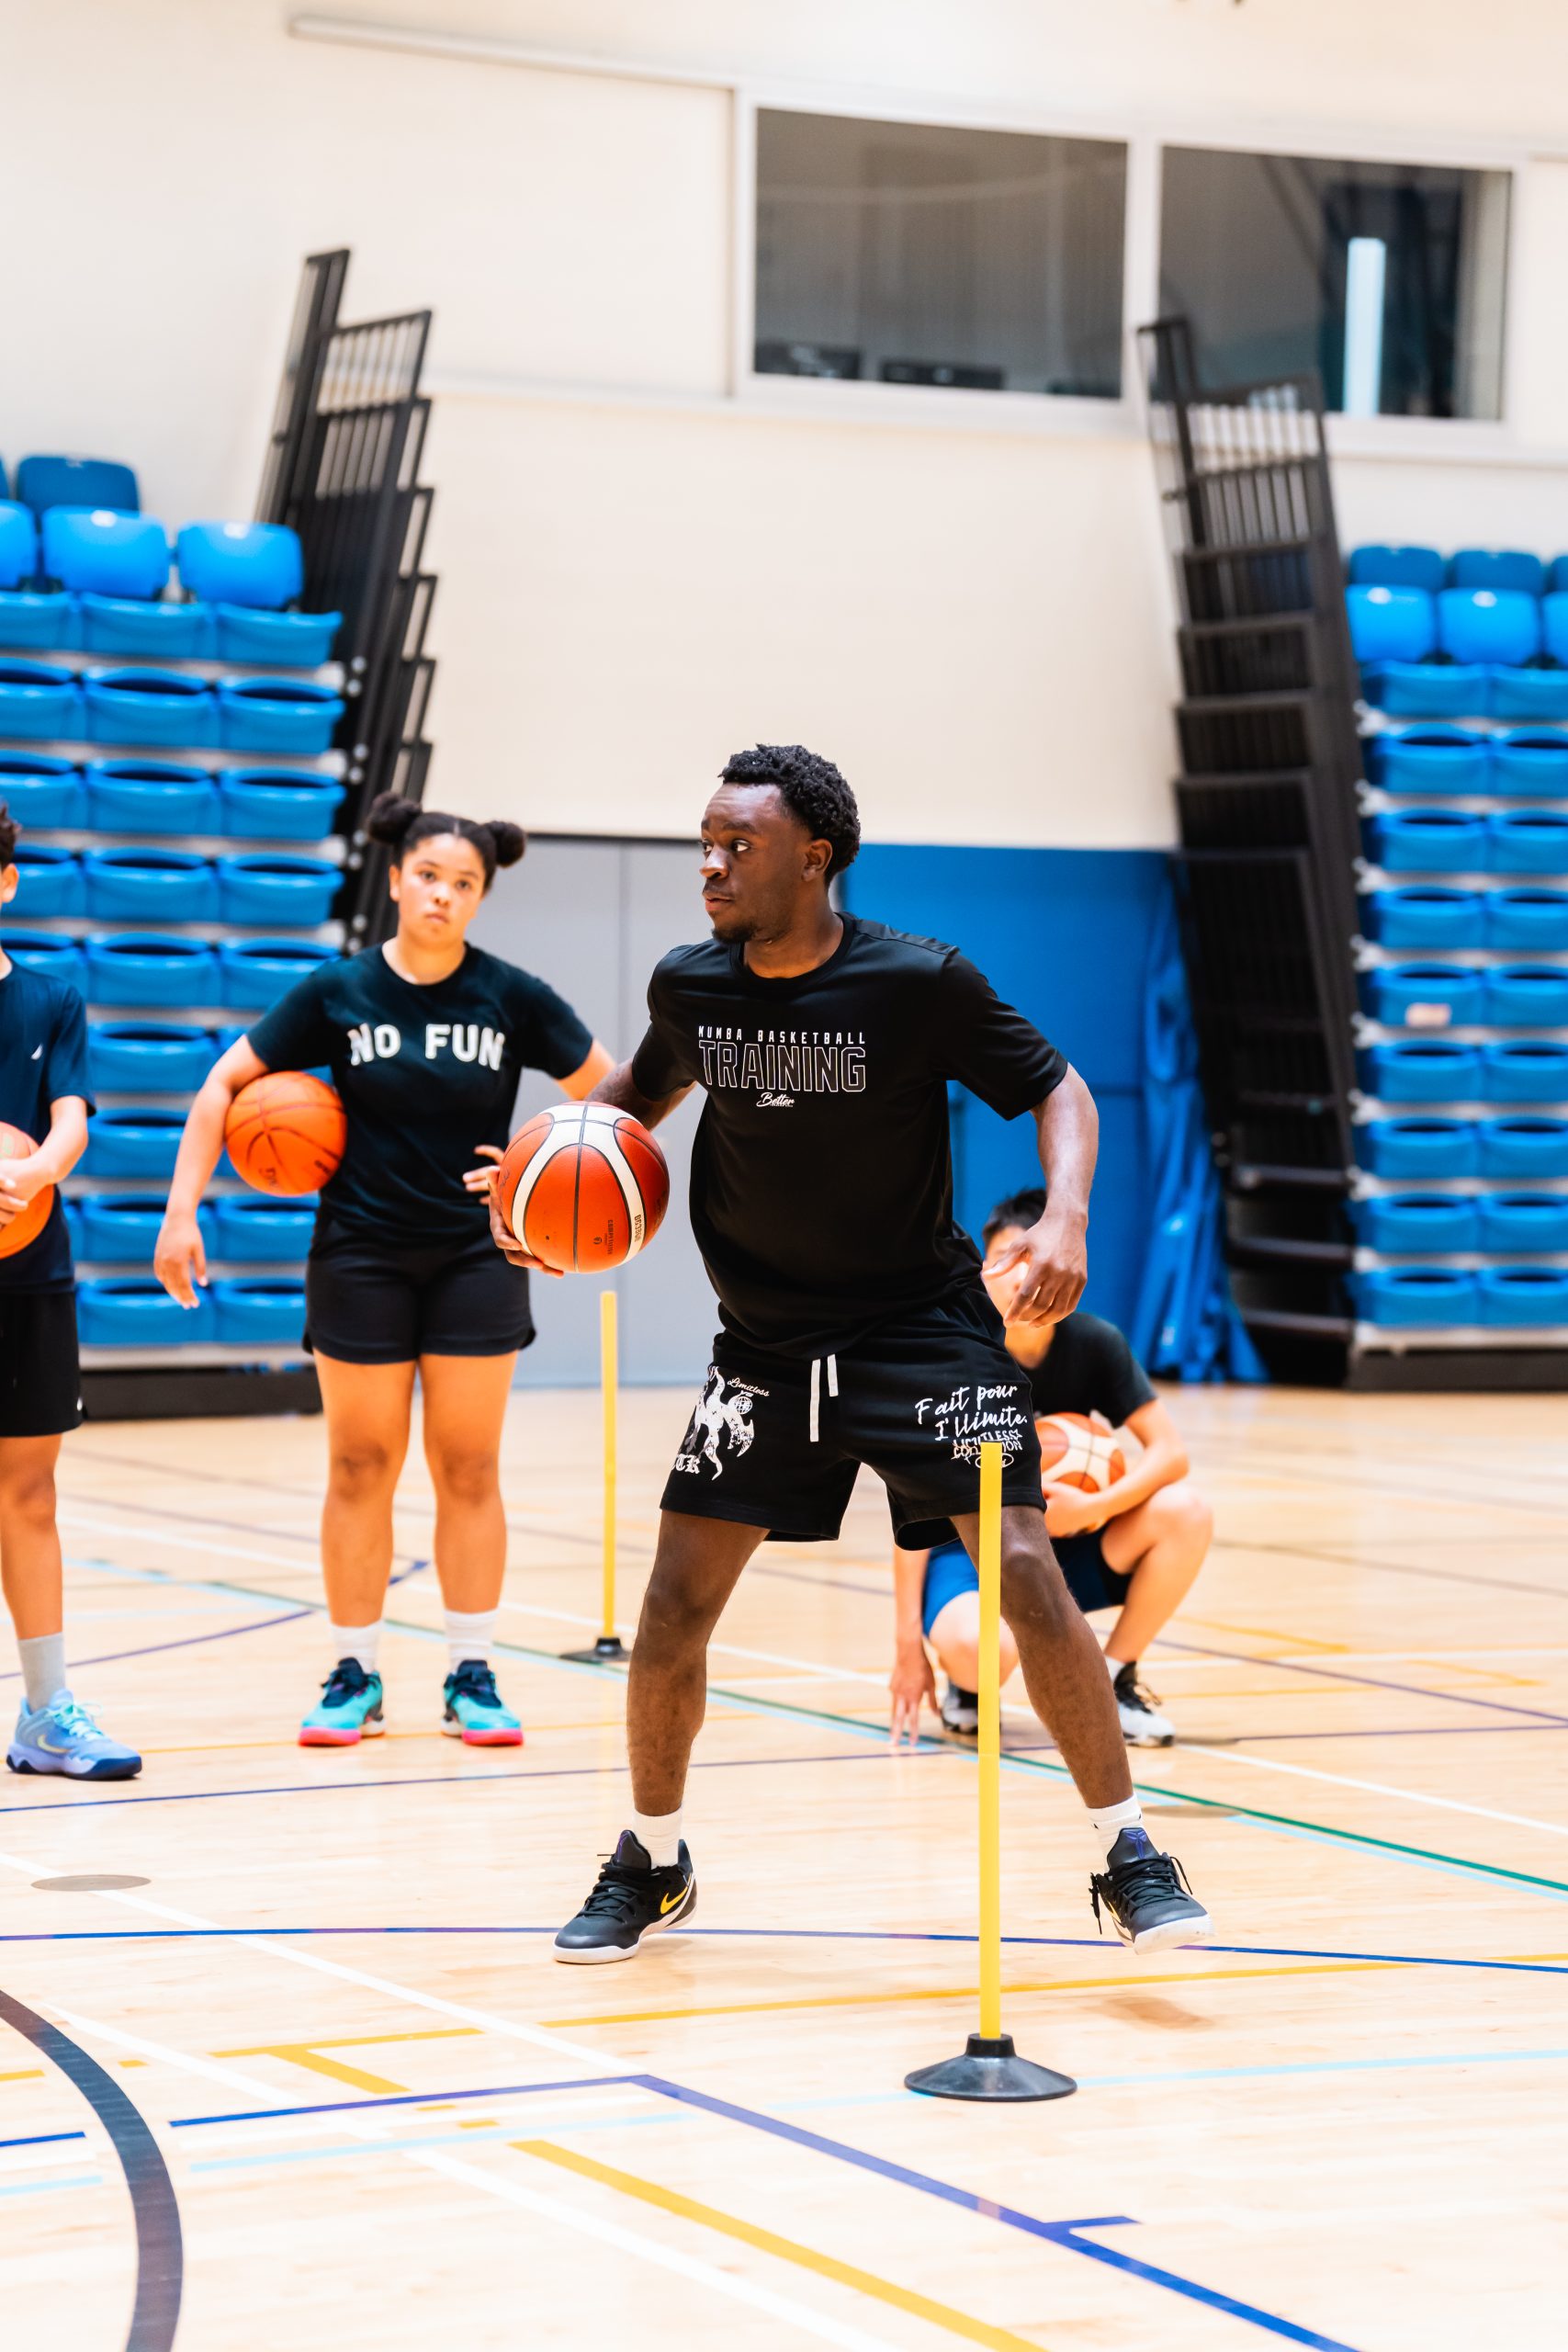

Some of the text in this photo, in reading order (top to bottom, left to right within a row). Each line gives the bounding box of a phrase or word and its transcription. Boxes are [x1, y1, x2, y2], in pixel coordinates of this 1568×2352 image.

[347, 1023, 505, 1071] NO FUN
[758, 1030, 865, 1045] BASKETBALL
[698, 1040, 866, 1092] TRAINING
[756, 1091, 795, 1107] Better
[727, 1377, 770, 1396] Limitless
[915, 1385, 1018, 1424] Fait pour
